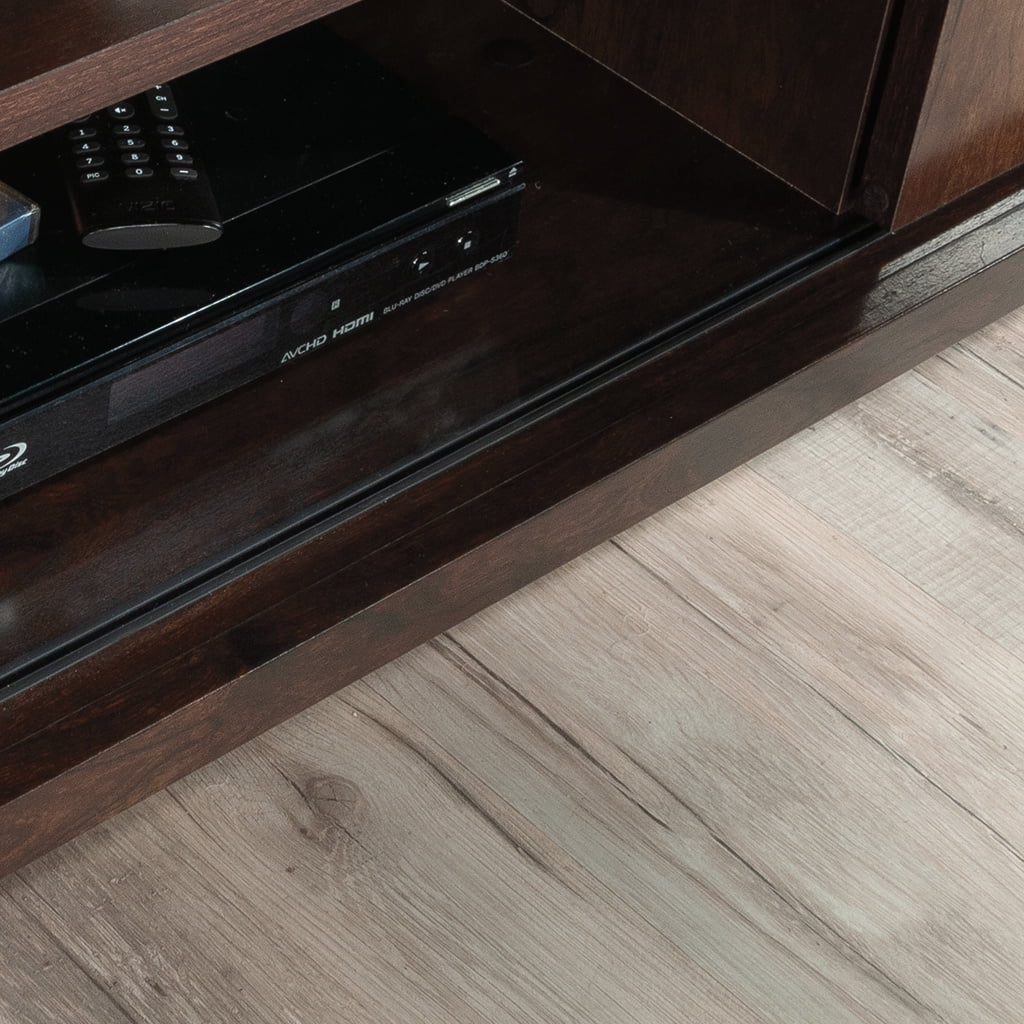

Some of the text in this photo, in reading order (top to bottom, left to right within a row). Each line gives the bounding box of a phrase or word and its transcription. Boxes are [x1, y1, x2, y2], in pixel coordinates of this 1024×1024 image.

[79, 128, 85, 136] 1
[85, 157, 92, 165] 7
[382, 294, 413, 315] BLU-RAY
[447, 266, 474, 284] PLAYER
[332, 311, 375, 339] HDMI
[280, 334, 328, 364] AVCHD
